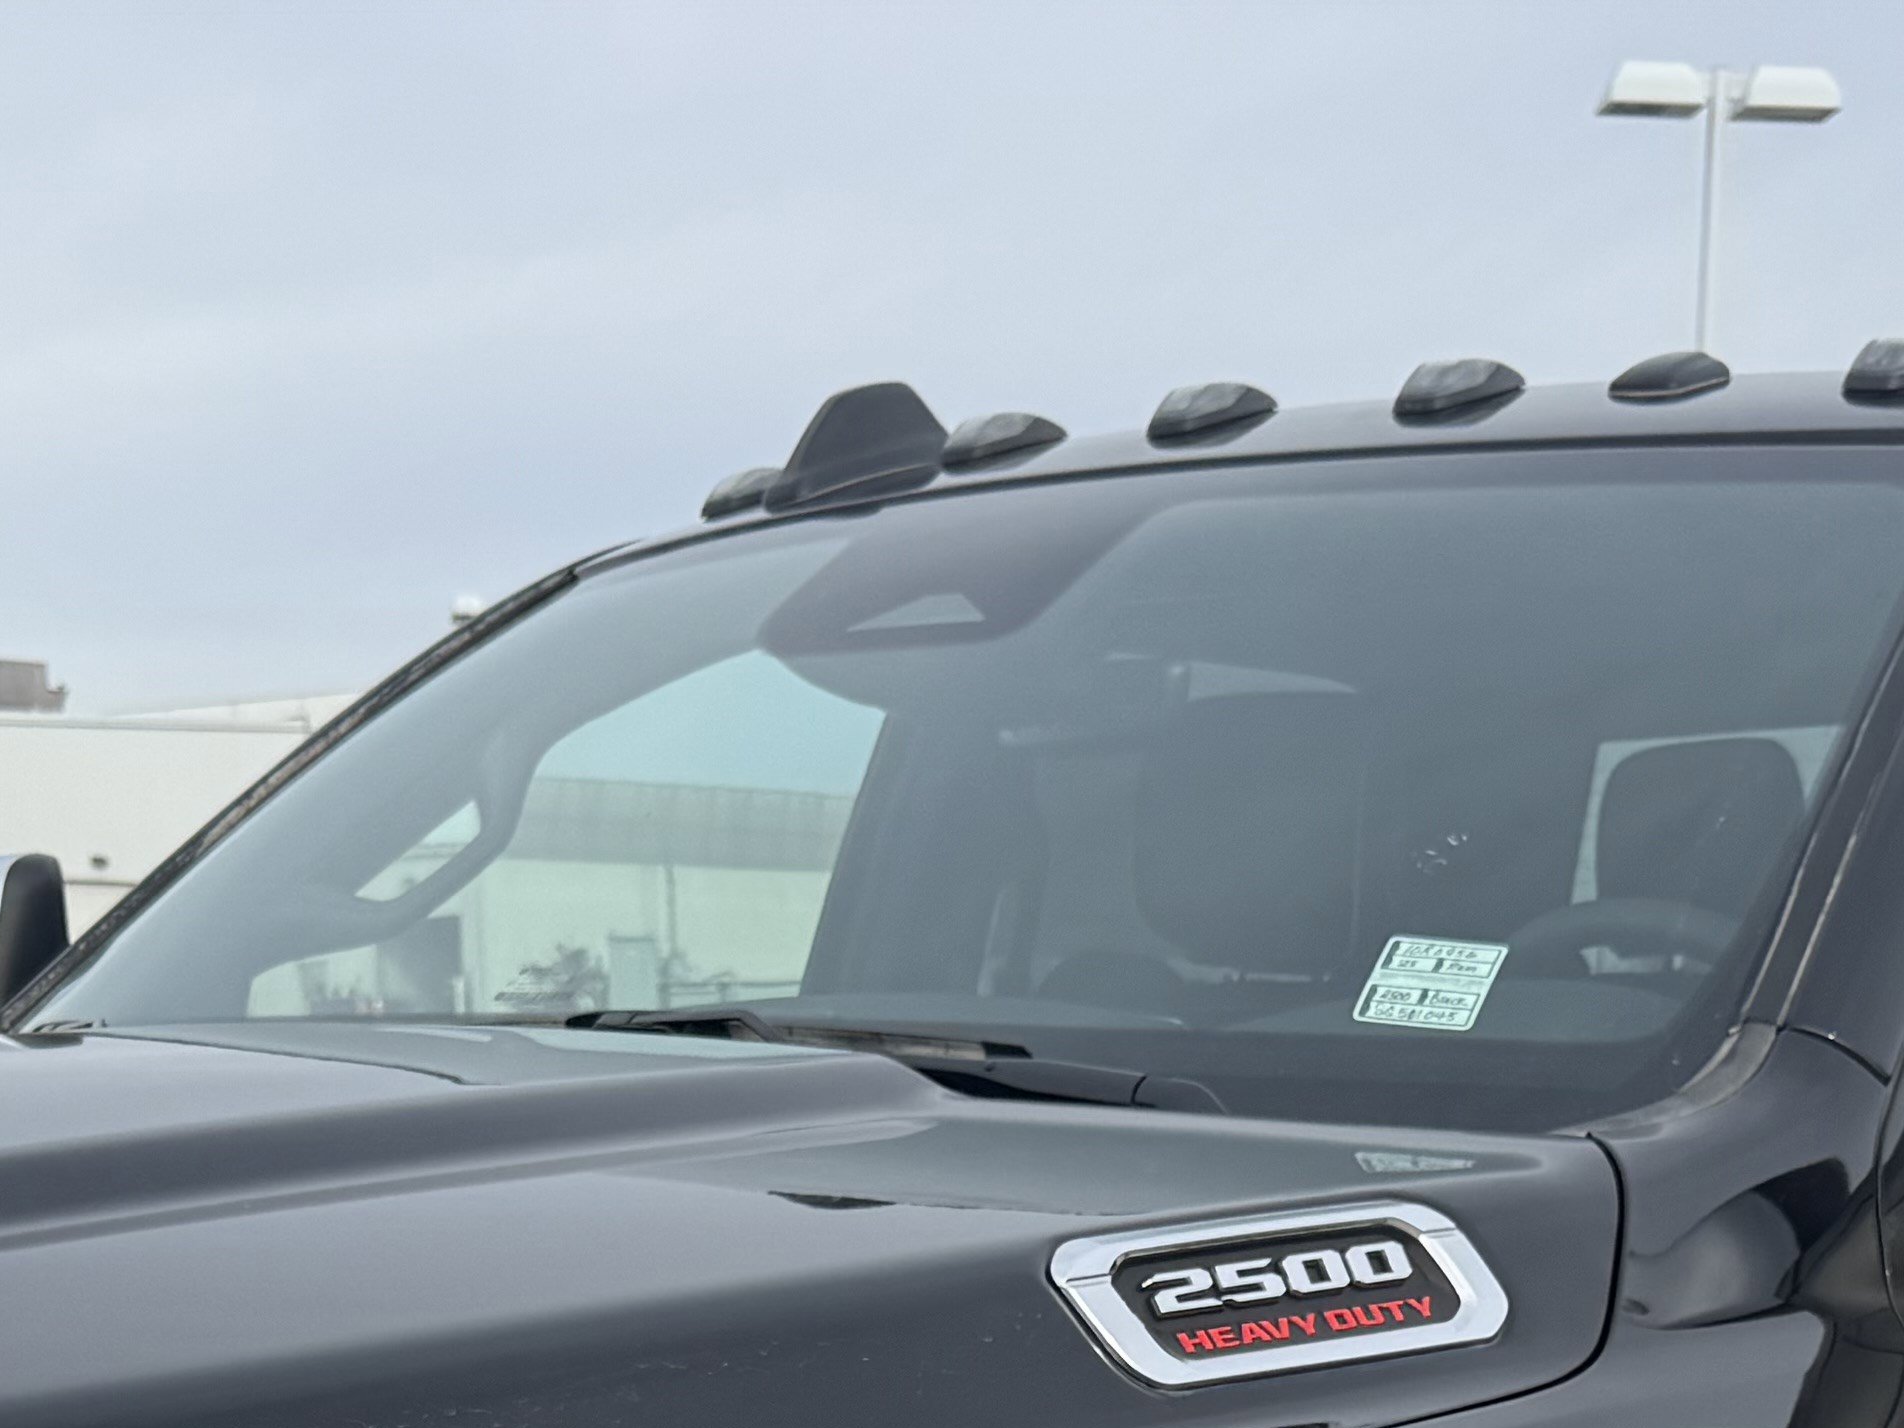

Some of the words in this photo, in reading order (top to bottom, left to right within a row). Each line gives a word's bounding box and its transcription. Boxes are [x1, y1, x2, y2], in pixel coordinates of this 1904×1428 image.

[1144, 1239, 1413, 1316] 2500
[1176, 1311, 1317, 1354] HEAVY
[1322, 1294, 1434, 1333] DUTY
